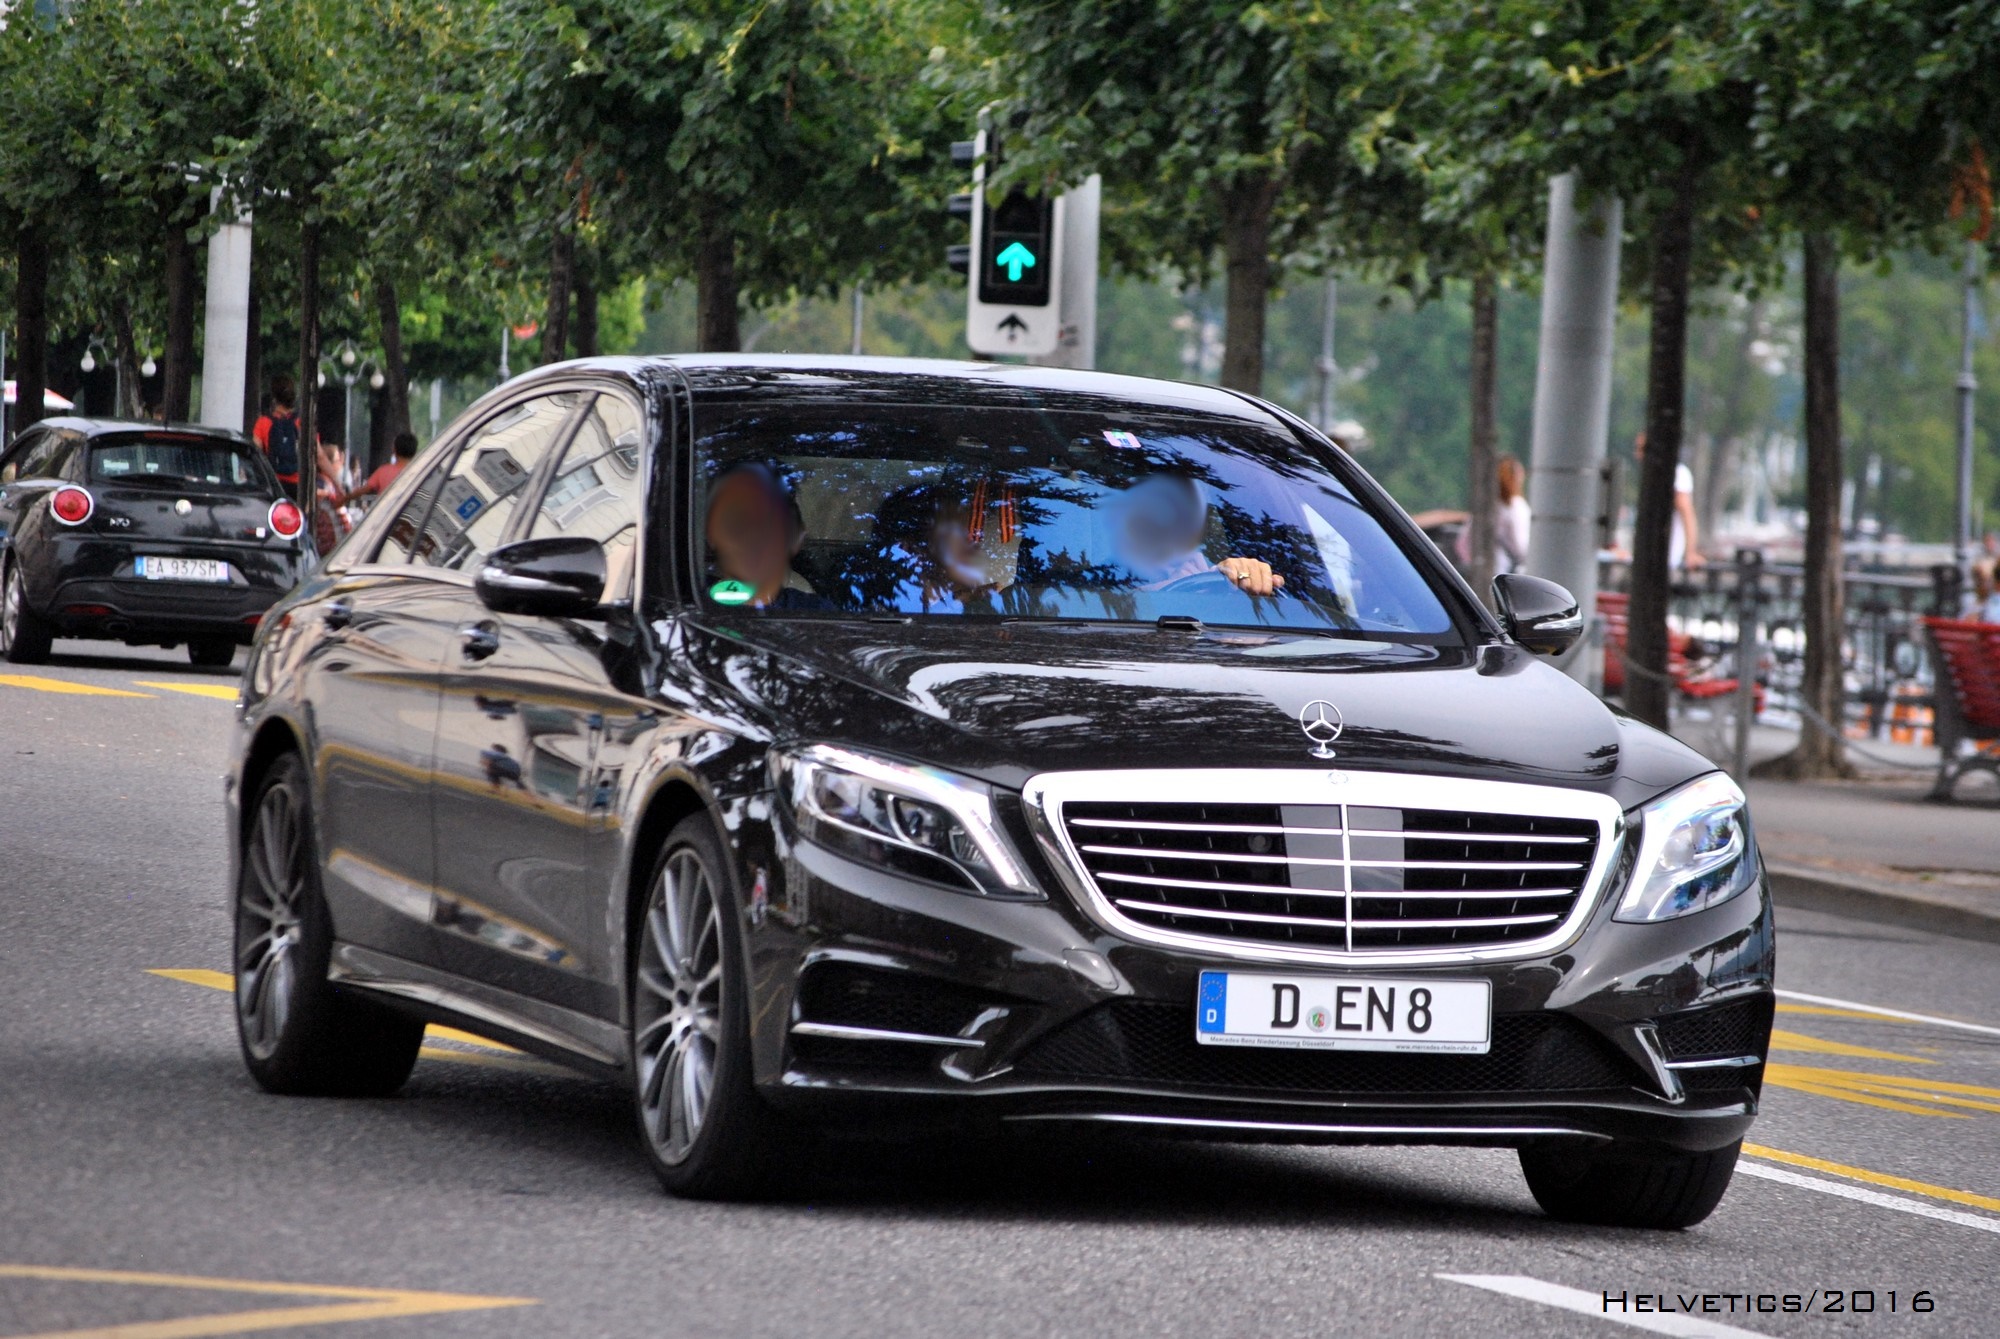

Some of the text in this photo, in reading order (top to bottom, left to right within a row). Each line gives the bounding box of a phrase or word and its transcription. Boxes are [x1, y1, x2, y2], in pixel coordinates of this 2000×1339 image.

[146, 557, 164, 573] EA
[726, 581, 738, 593] 4
[1271, 983, 1300, 1029] D
[1206, 1009, 1217, 1024] D
[1302, 1040, 1335, 1048] Düsseldorf
